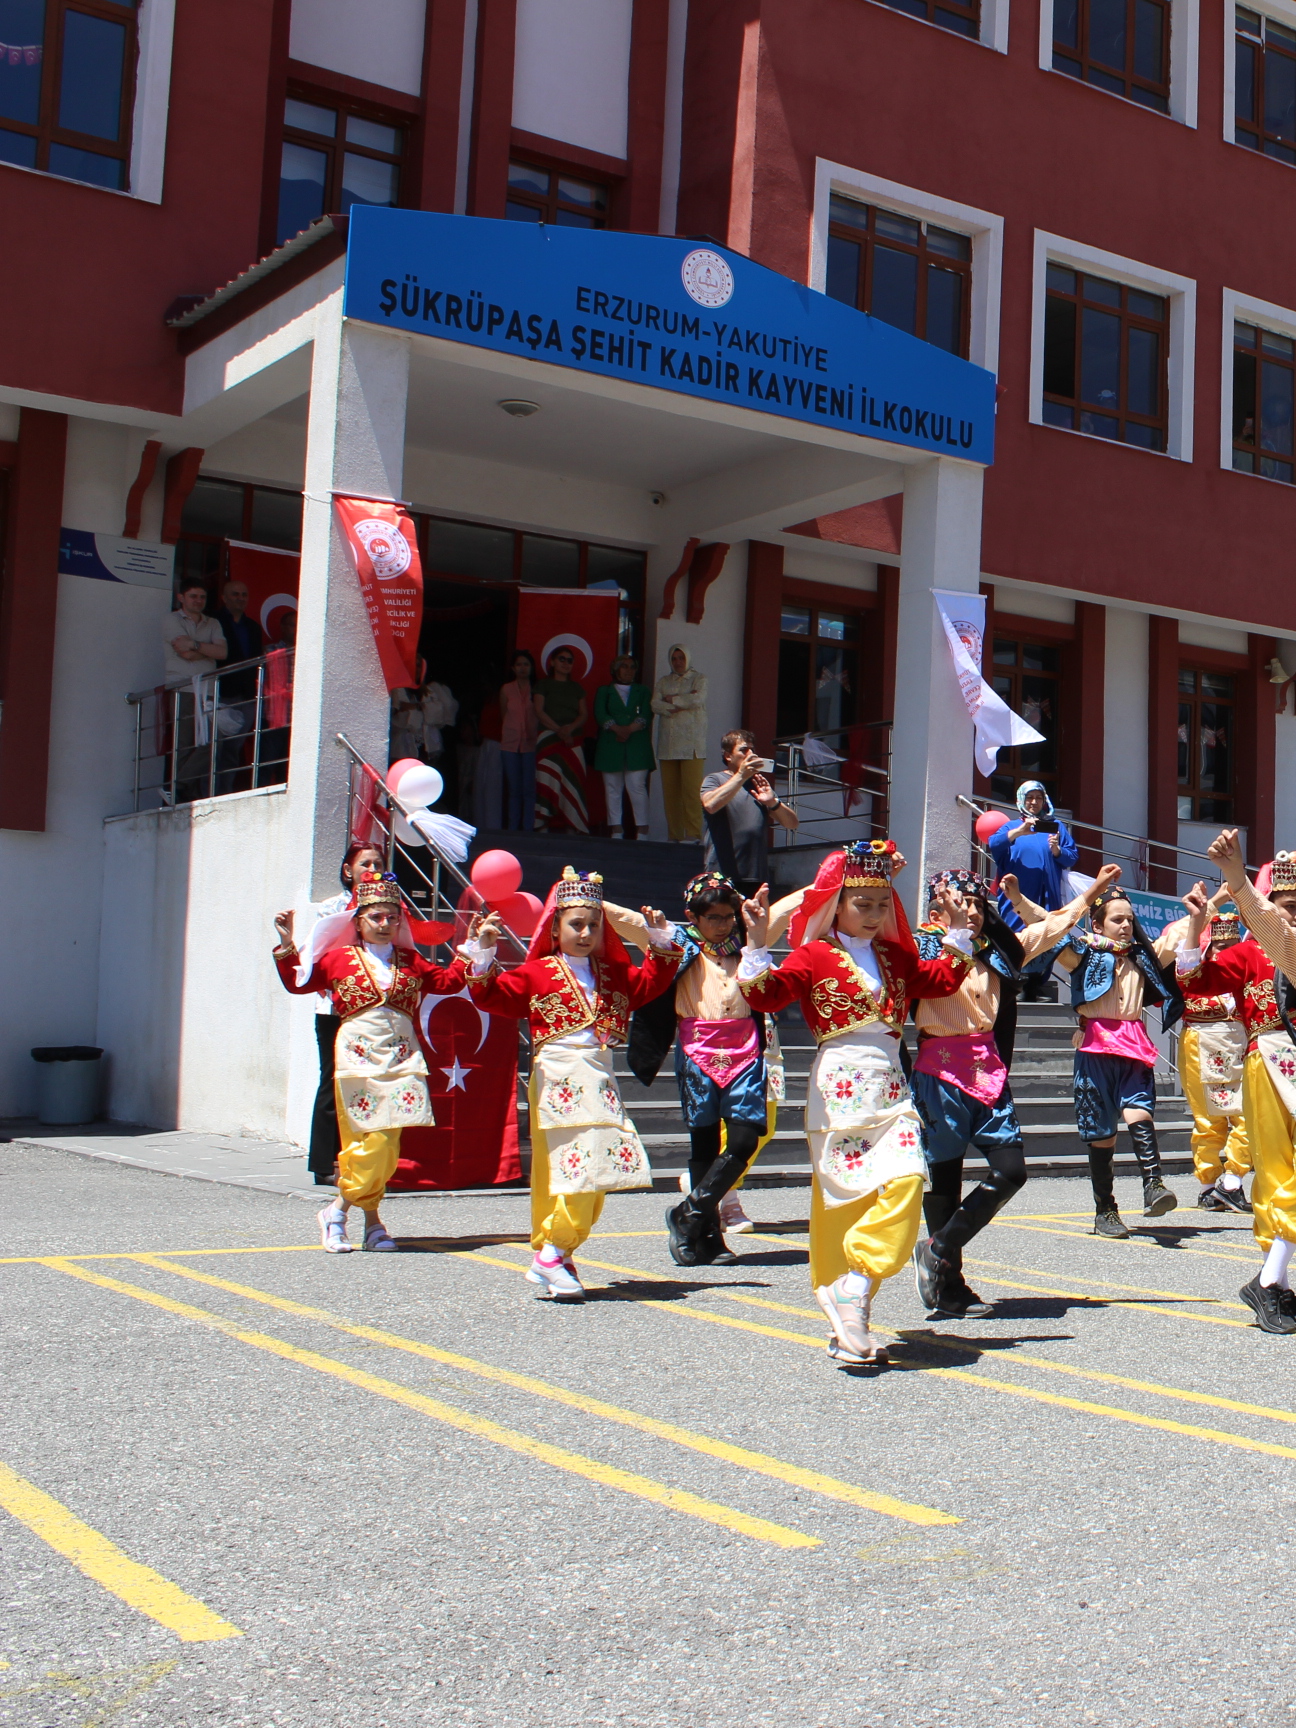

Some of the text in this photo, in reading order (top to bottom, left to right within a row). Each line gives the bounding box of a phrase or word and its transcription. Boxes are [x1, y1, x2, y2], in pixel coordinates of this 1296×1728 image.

[379, 277, 974, 449] ŞÜKRÜPAŞA ŞEHİT KADİR KAYVENİ İLKOKULU
[575, 286, 829, 373] ERZURUM-YAKUTİYE
[380, 588, 417, 596] MHURİYETİ
